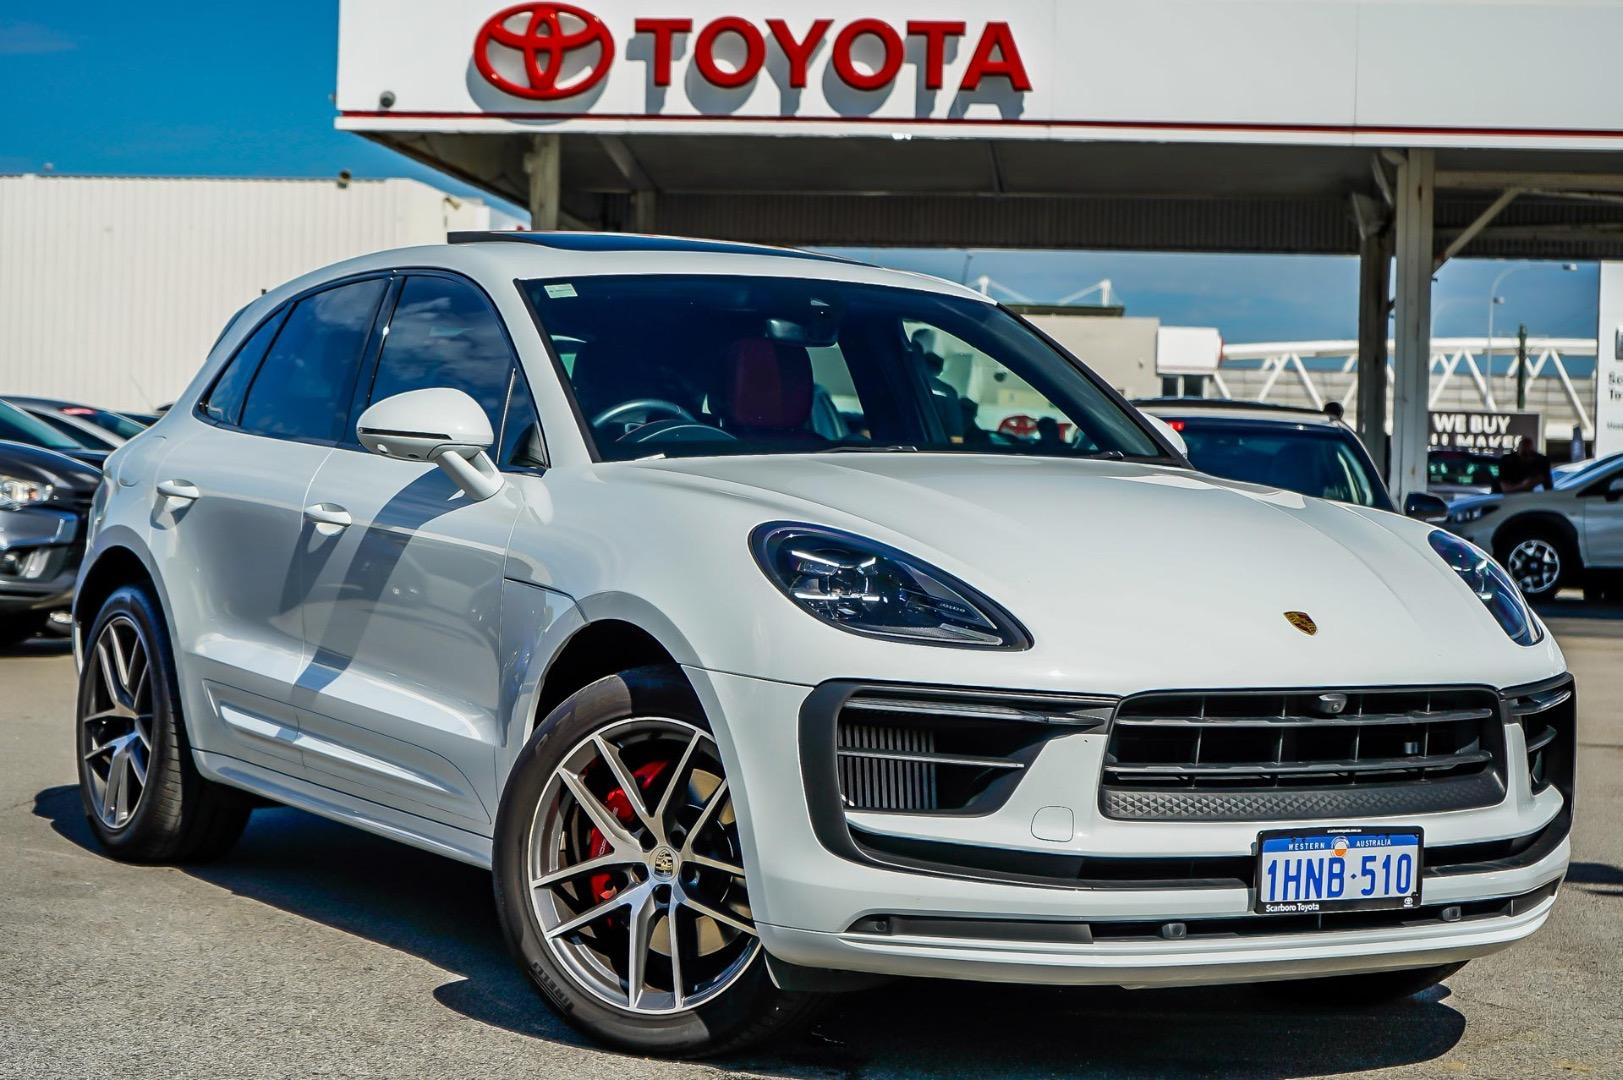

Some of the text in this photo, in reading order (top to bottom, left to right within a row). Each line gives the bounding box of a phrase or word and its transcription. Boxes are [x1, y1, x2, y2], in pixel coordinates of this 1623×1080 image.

[634, 16, 1032, 91] TOYOTA
[1432, 413, 1511, 434] WE BUY
[1288, 839, 1392, 851] WESTERN AUSTRALIA
[1265, 902, 1320, 913] Scarboro Toyota
